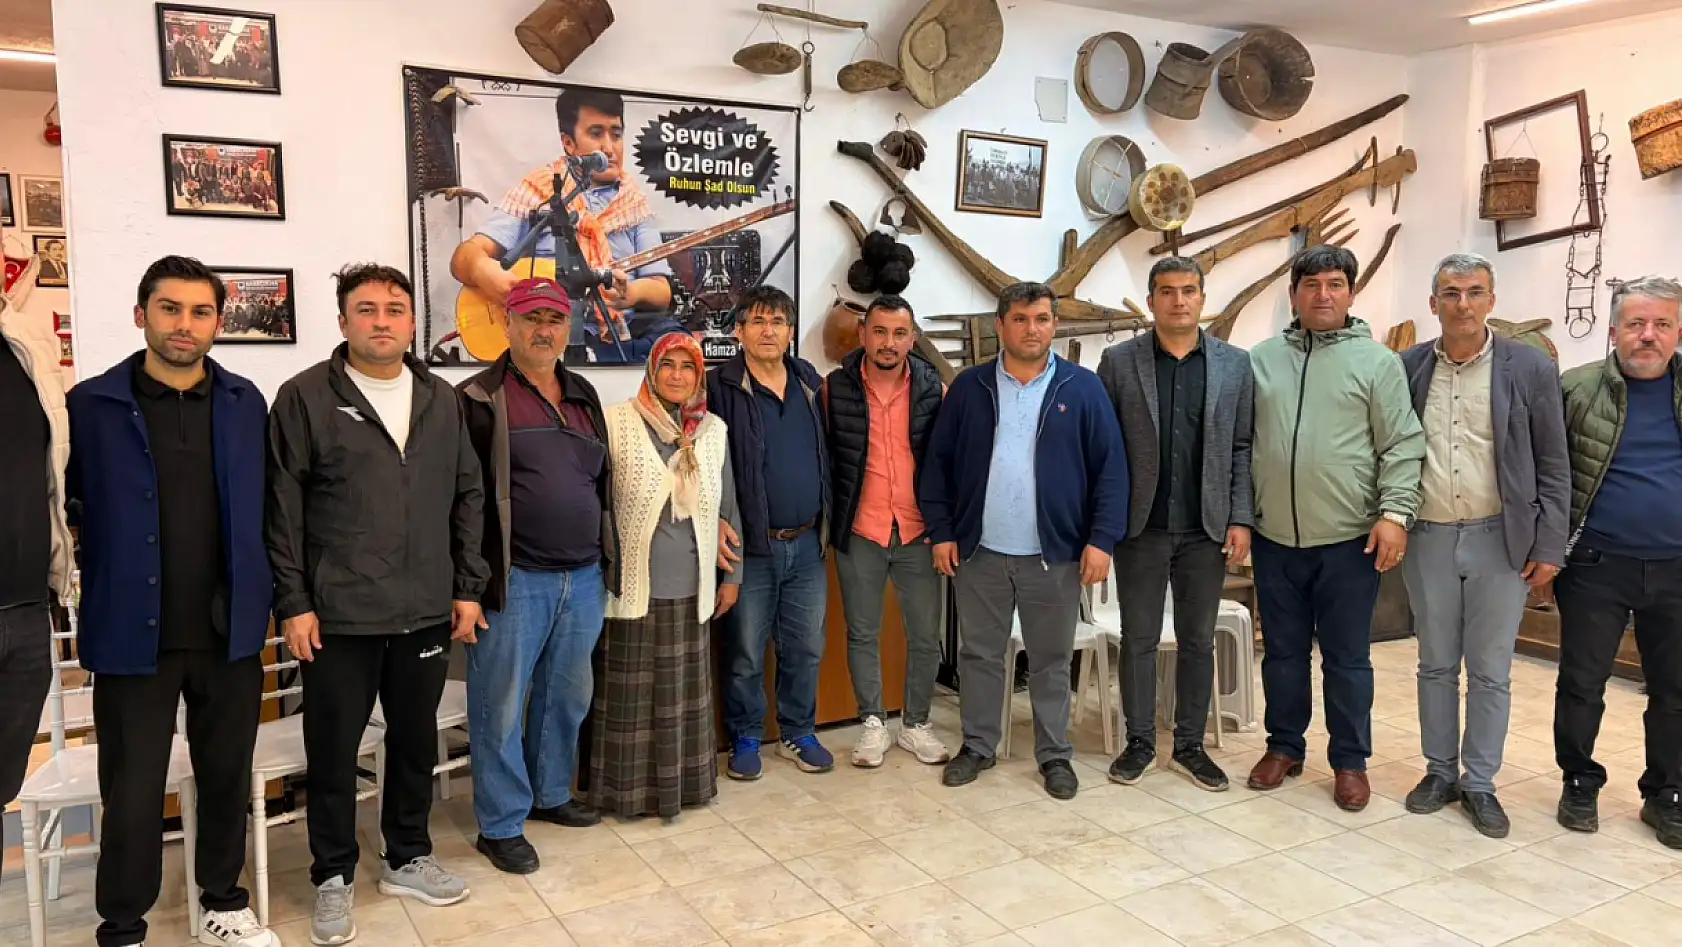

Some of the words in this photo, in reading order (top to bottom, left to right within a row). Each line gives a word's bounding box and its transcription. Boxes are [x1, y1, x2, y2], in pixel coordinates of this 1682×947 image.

[660, 122, 725, 150] Sevgi
[732, 133, 757, 149] ve
[665, 146, 754, 177] Özlemle
[669, 176, 702, 191] Ruhun
[727, 181, 756, 194] Olsun
[705, 342, 737, 357] Hamza
